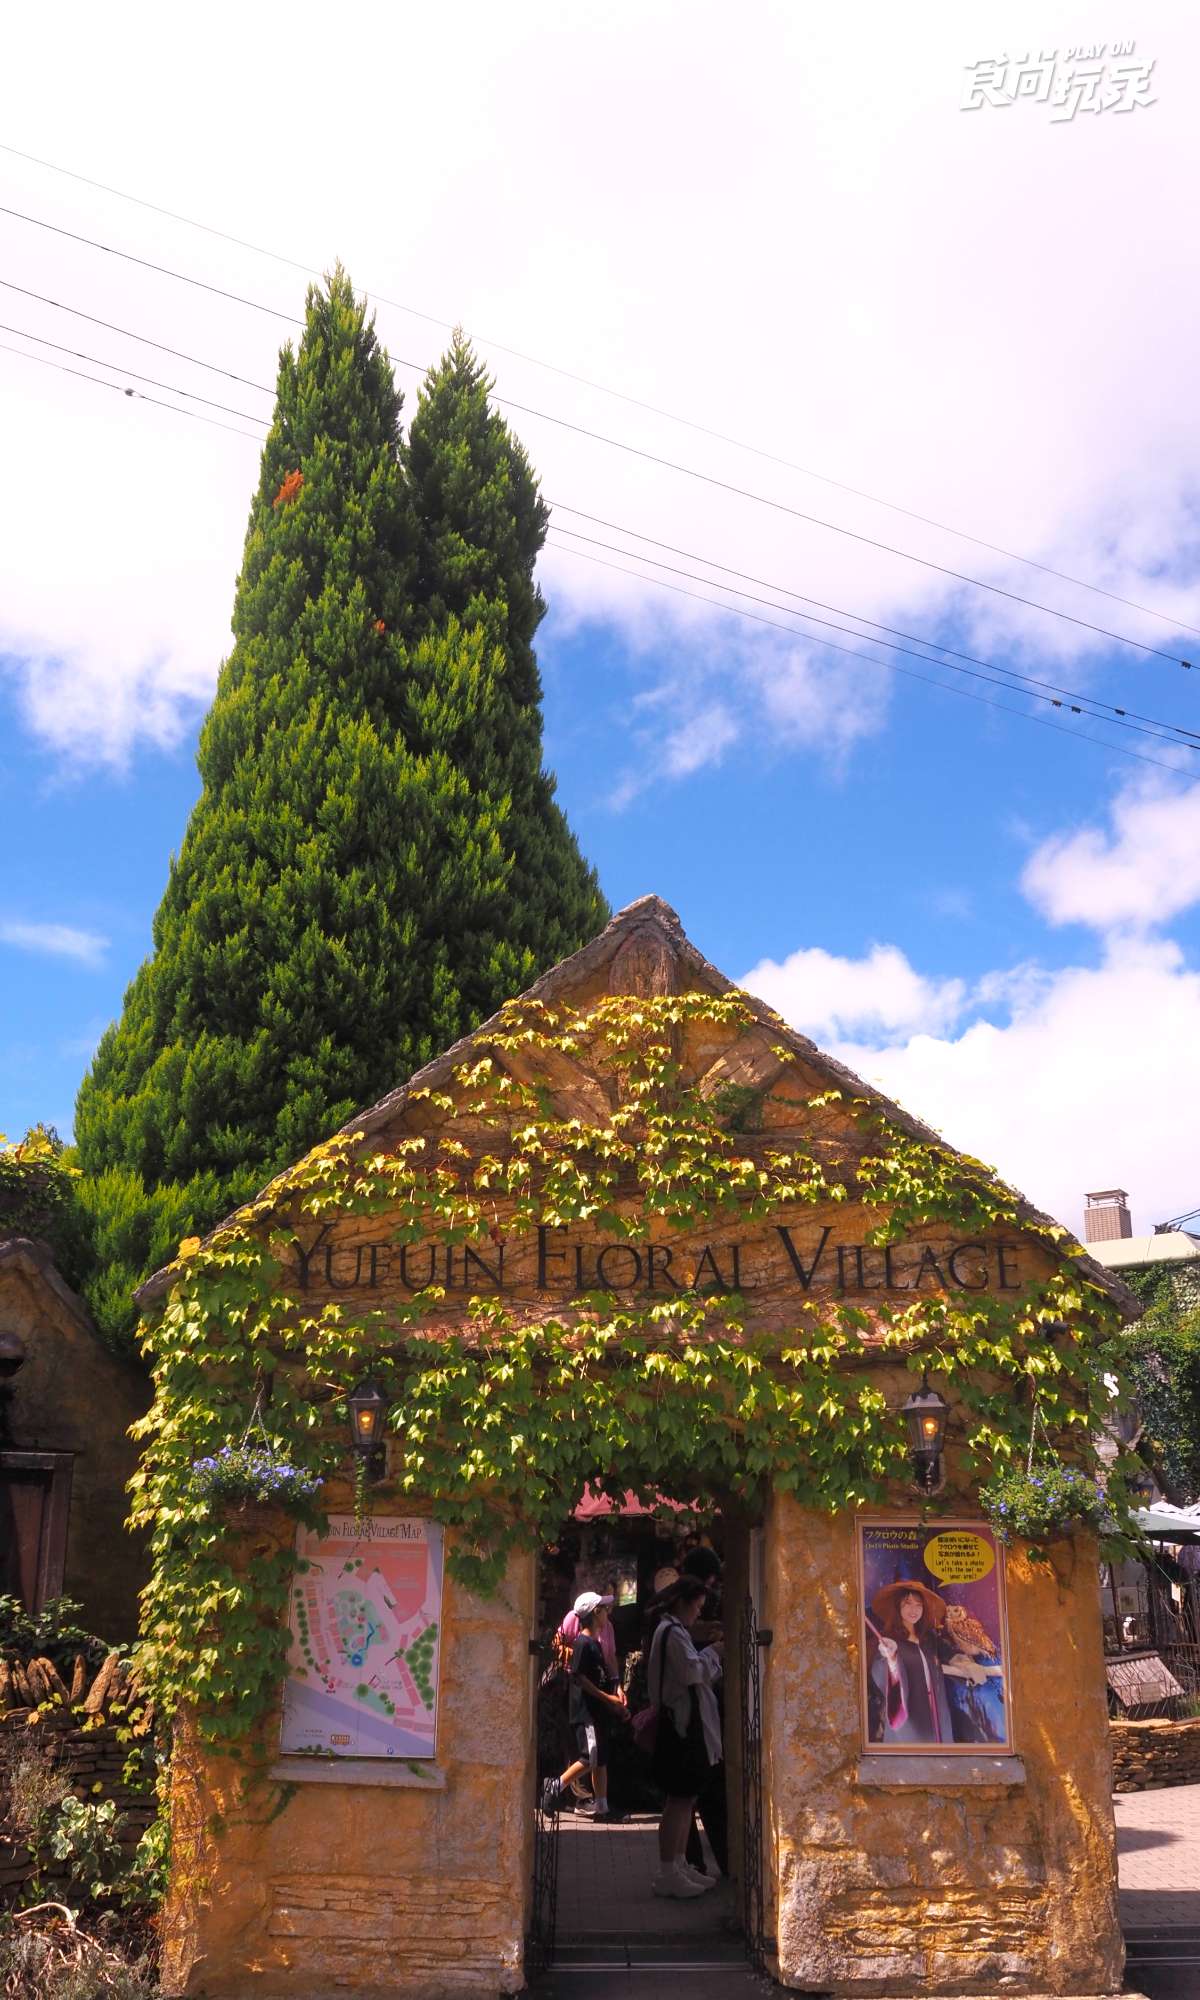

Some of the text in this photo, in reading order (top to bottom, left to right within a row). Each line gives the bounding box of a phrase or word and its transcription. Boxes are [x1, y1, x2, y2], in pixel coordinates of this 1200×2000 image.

[289, 1222, 1022, 1292] YUFUIN FLORAL VILLAGE
[342, 1521, 369, 1537] FLOAL
[399, 1523, 422, 1539] MAP
[865, 1530, 917, 1541] フクロウの森
